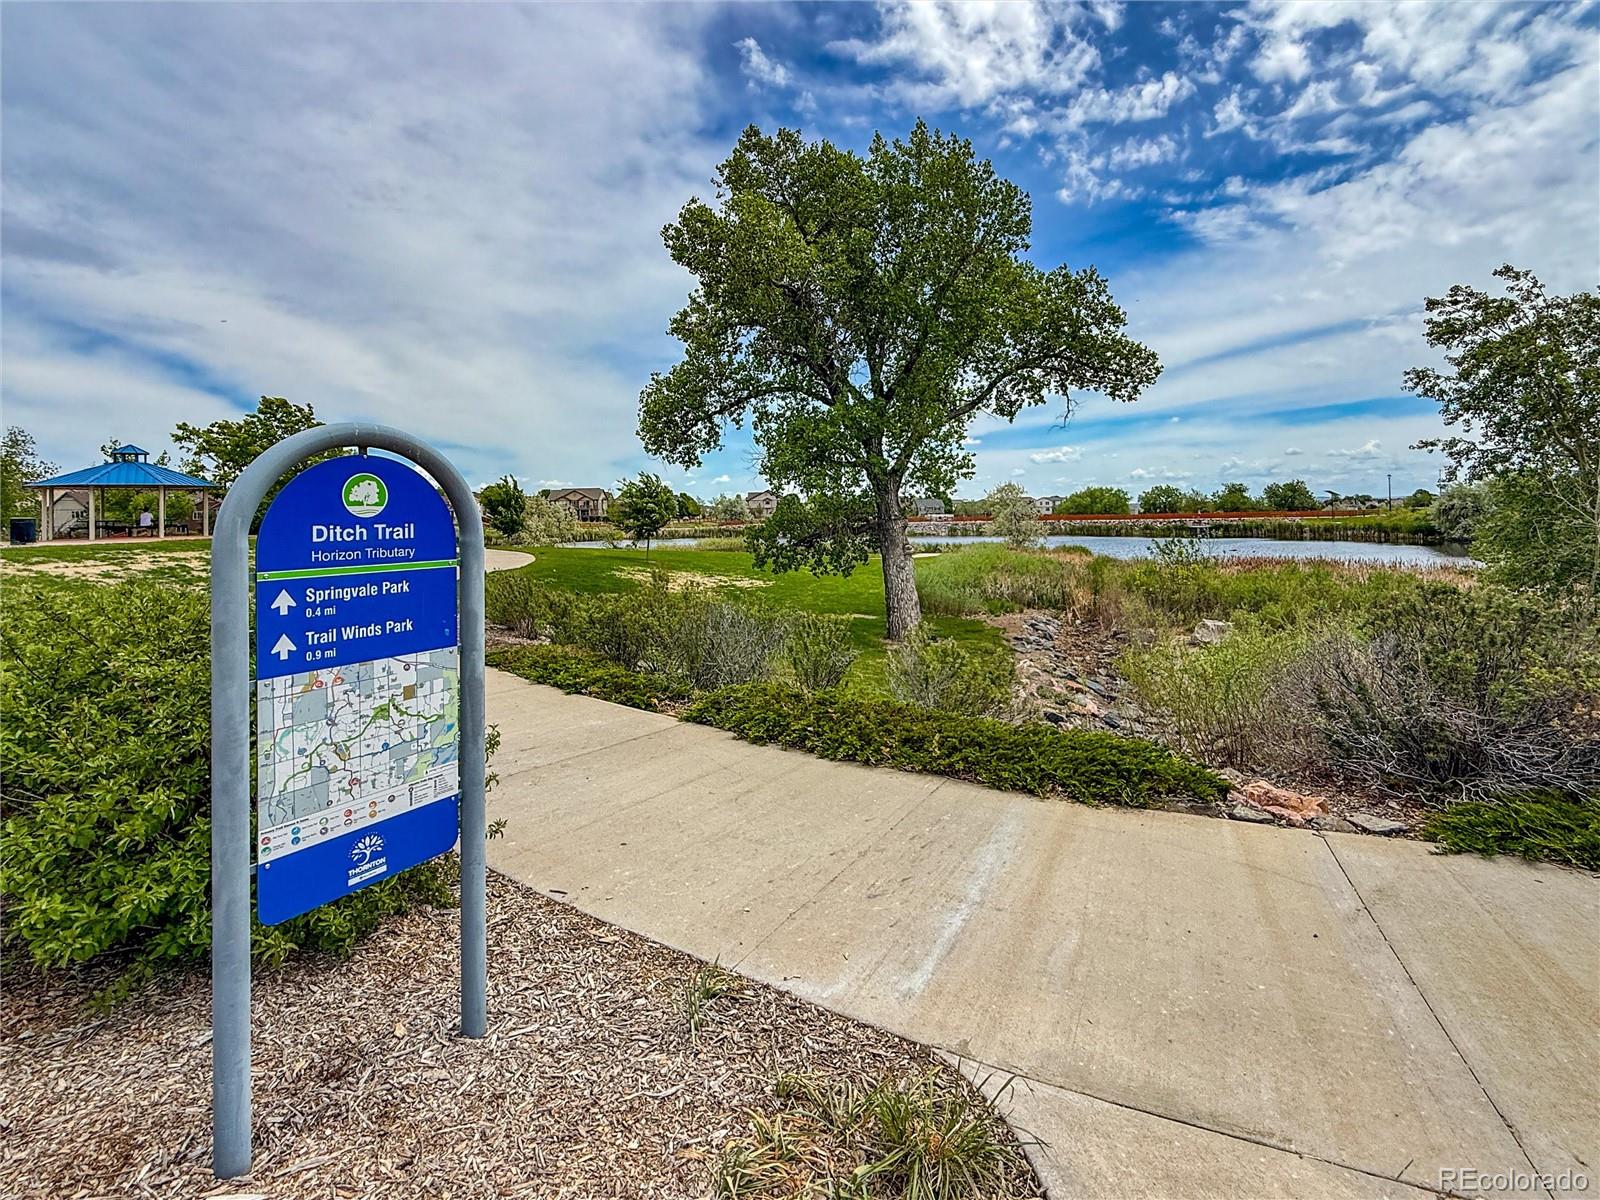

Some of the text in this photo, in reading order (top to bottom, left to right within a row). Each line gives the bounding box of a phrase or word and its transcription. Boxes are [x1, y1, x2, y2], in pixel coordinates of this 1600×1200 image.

[312, 523, 415, 542] Ditch Trail
[311, 547, 415, 562] Horizon Tributary
[306, 580, 409, 604] Springvale Park
[306, 605, 336, 618] 0.4 mi
[306, 618, 413, 645] Trail Winds Park
[306, 648, 336, 661] 0.9 mi
[348, 857, 386, 877] THORNTON
